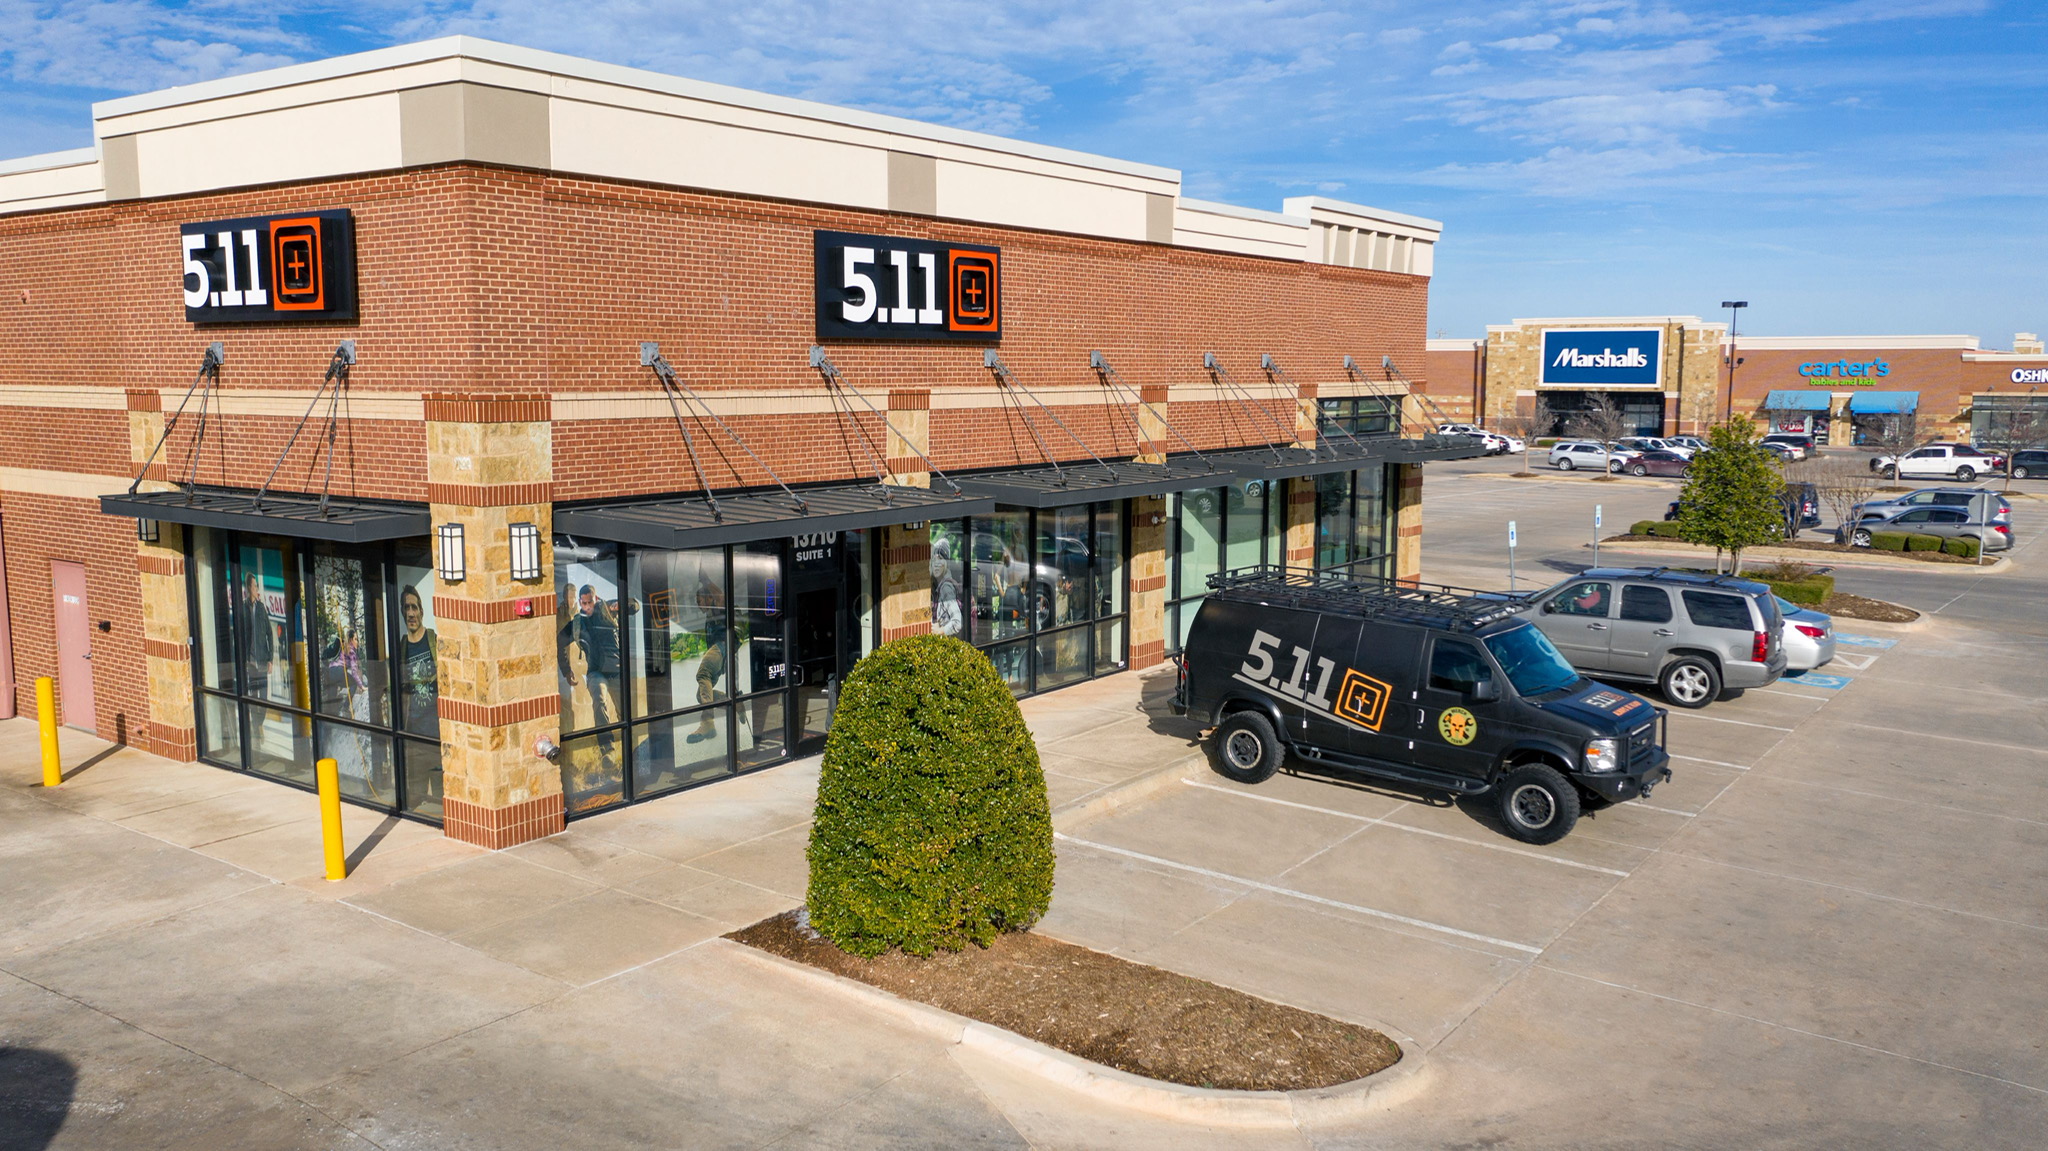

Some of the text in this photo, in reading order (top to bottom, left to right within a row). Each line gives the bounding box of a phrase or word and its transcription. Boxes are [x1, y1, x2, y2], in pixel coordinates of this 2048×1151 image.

[182, 228, 267, 308] 5.11
[842, 246, 943, 325] 5.11
[1552, 348, 1648, 367] Marshalls
[1799, 358, 1890, 376] carter's
[1810, 377, 1876, 386] babies and kids
[796, 548, 832, 562] SUITE 1
[1241, 629, 1335, 711] 5.11
[1586, 694, 1617, 708] 5.11
